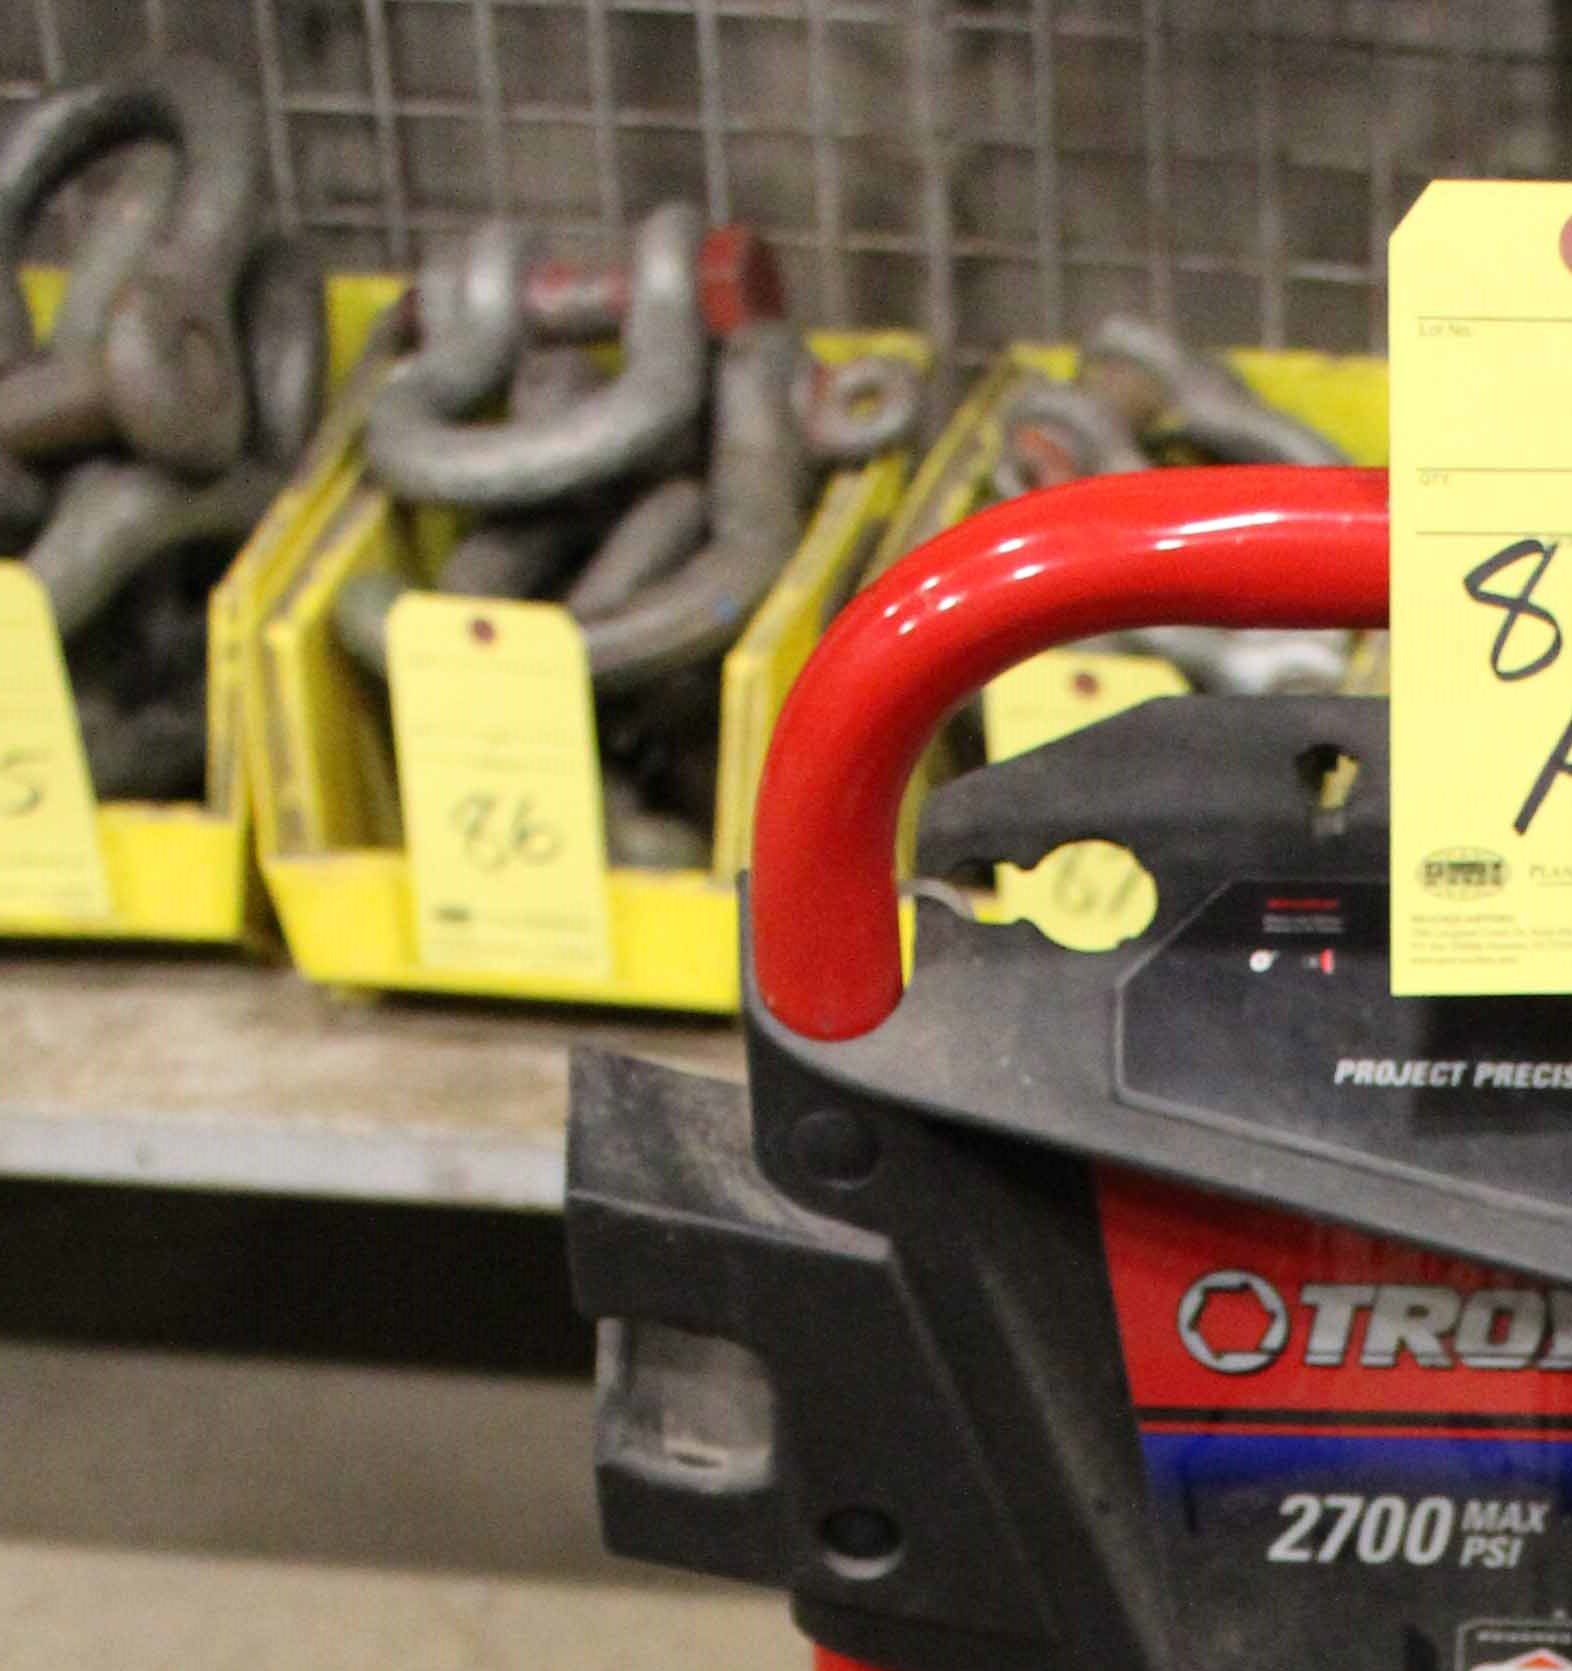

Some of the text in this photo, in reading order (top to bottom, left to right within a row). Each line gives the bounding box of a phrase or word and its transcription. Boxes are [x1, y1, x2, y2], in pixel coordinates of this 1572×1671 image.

[1334, 1058, 1467, 1087] PROJECT
[1267, 1493, 1549, 1567] 2700 MAX
[1459, 1537, 1522, 1569] PSI
